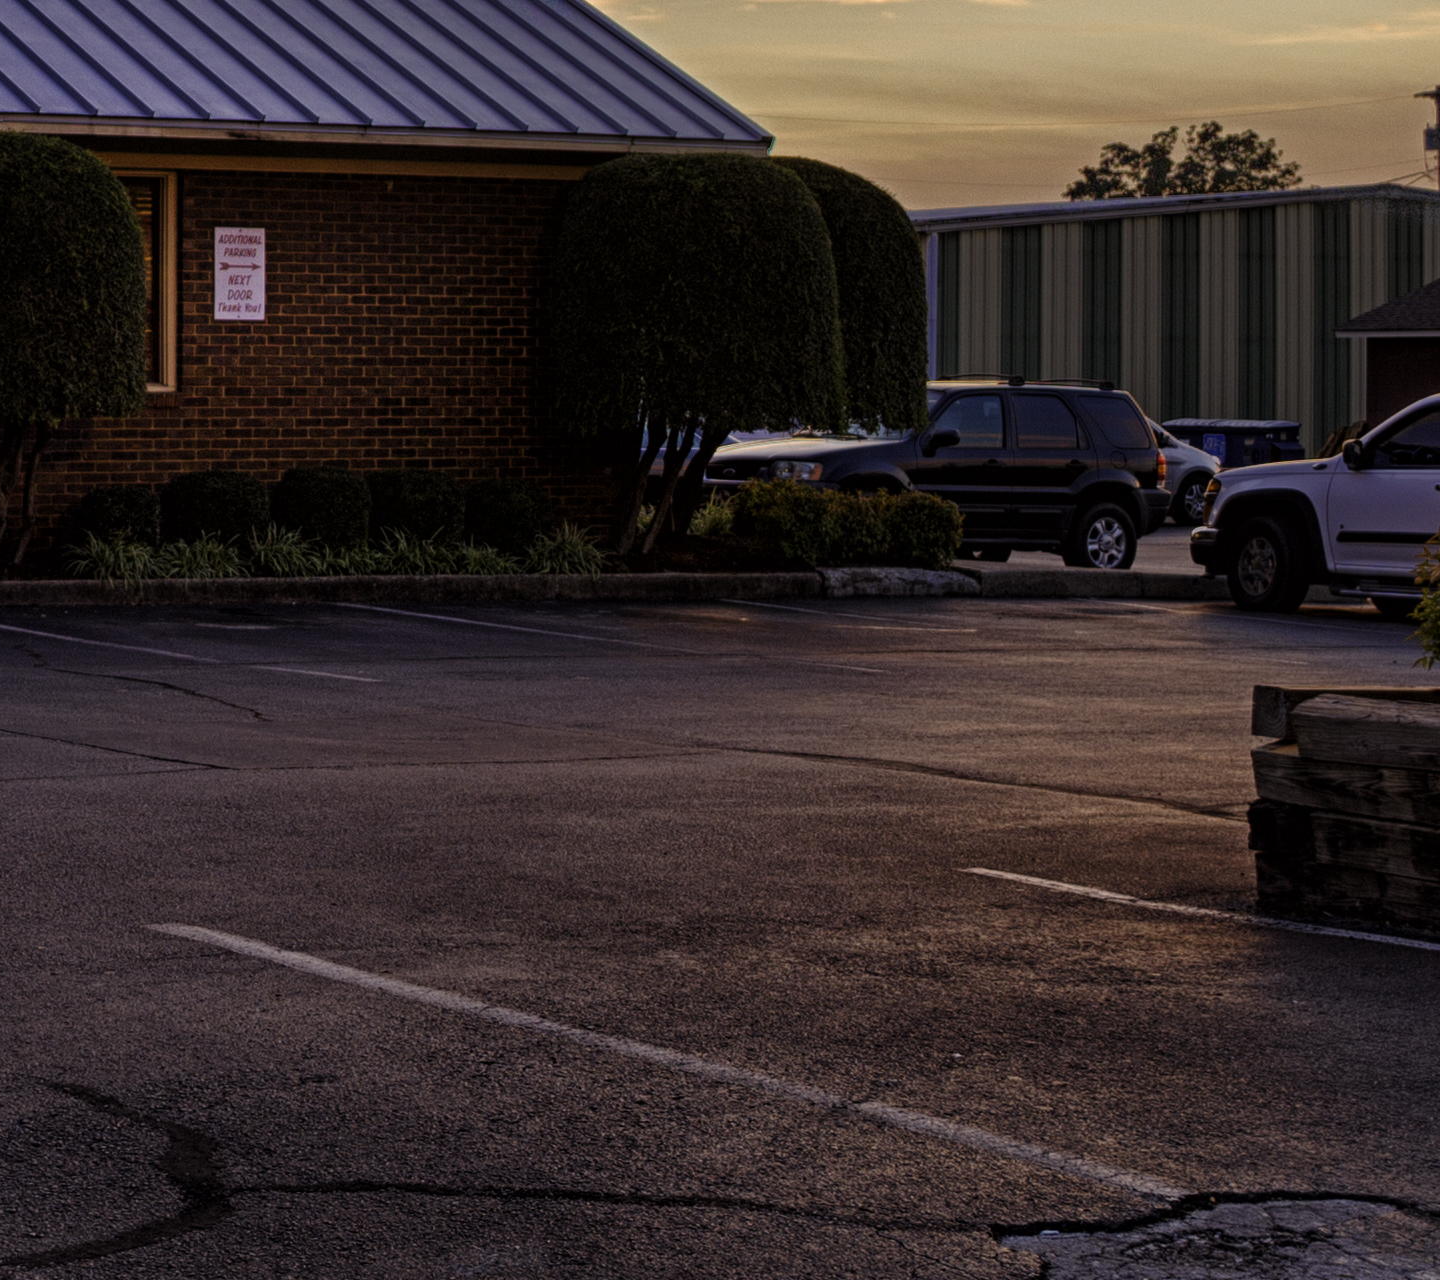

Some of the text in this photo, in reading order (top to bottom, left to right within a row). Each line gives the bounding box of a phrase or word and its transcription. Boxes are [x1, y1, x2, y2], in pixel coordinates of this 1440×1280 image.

[218, 234, 262, 245] ADDITIONAL
[223, 247, 257, 258] PARKING
[228, 274, 252, 286] NEXT
[227, 289, 253, 301] DOOR
[218, 302, 241, 313] Thank
